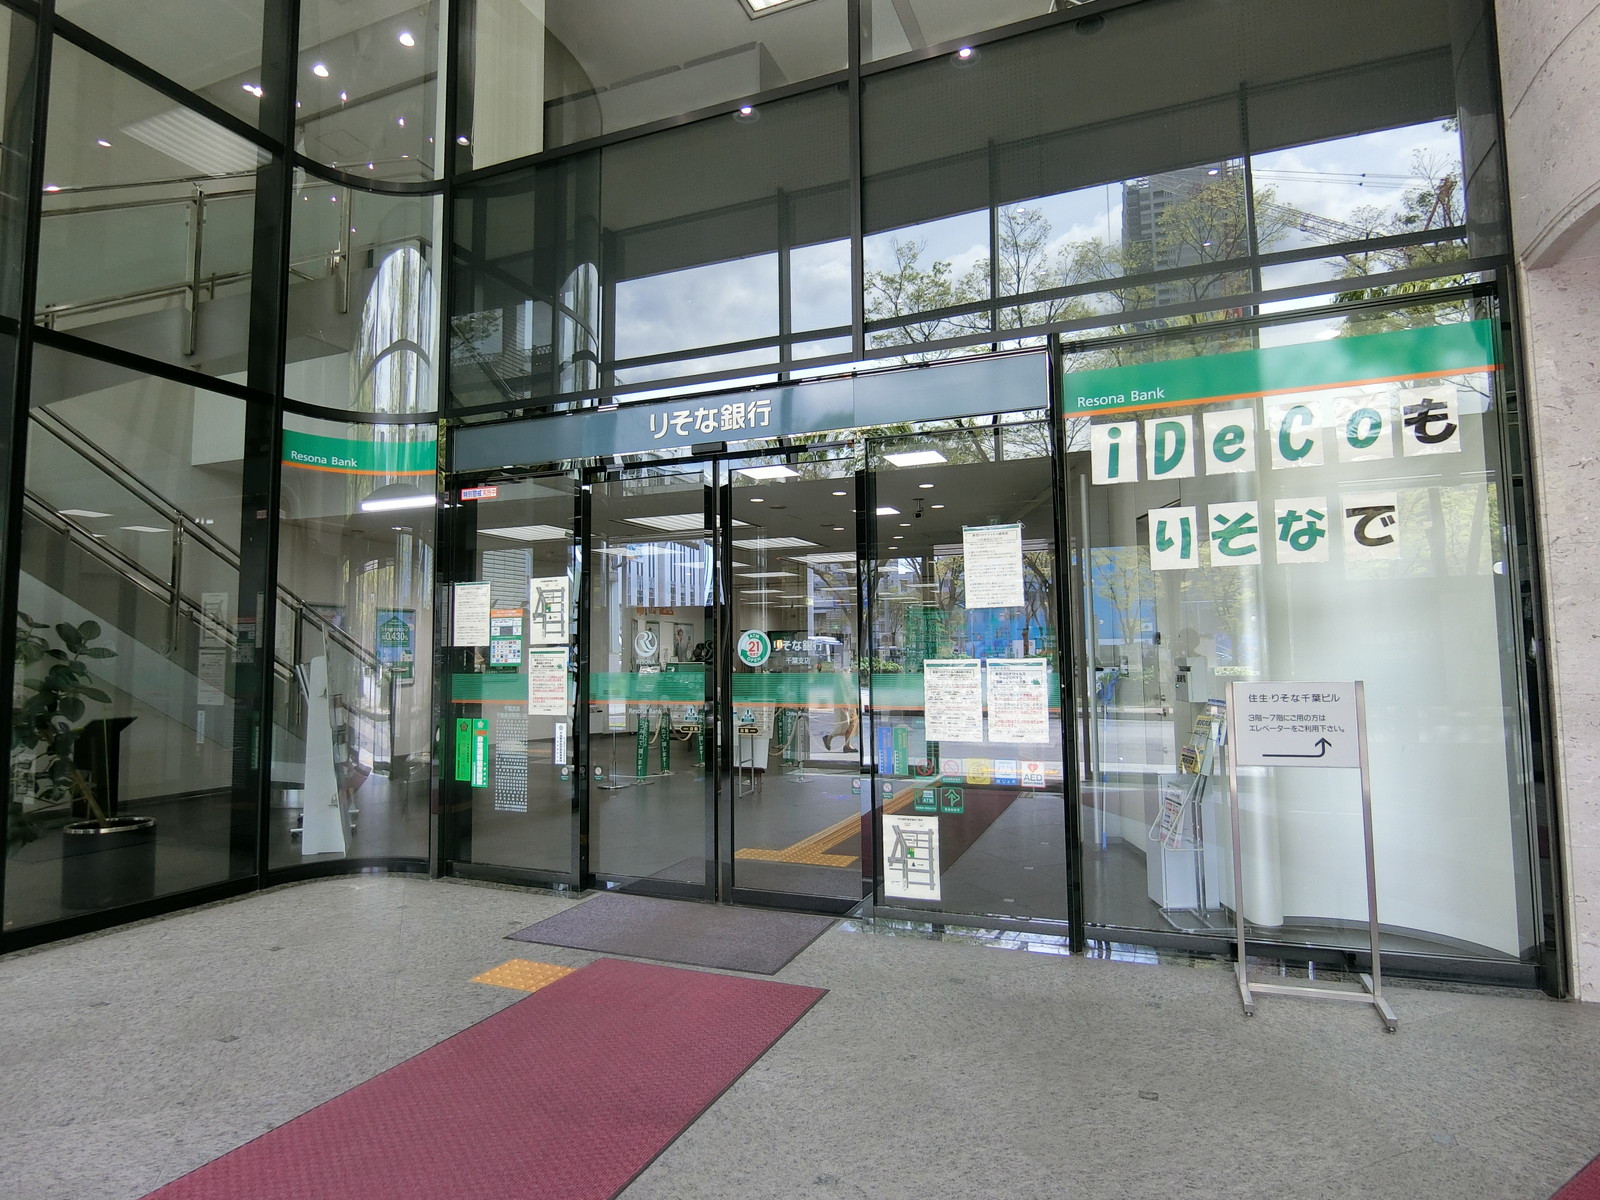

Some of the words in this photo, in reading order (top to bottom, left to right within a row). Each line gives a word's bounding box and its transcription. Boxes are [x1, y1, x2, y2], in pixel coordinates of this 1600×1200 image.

[1077, 394, 1125, 408] Resona
[1131, 387, 1165, 402] Bank
[649, 399, 772, 439] りそな銀行
[291, 450, 327, 464] Resona
[331, 456, 357, 467] Bank
[1155, 505, 1396, 560] りそなで
[748, 641, 760, 652] 21
[1249, 725, 1345, 733] エレベーターをご利用下さい。
[1023, 773, 1043, 782] AED
